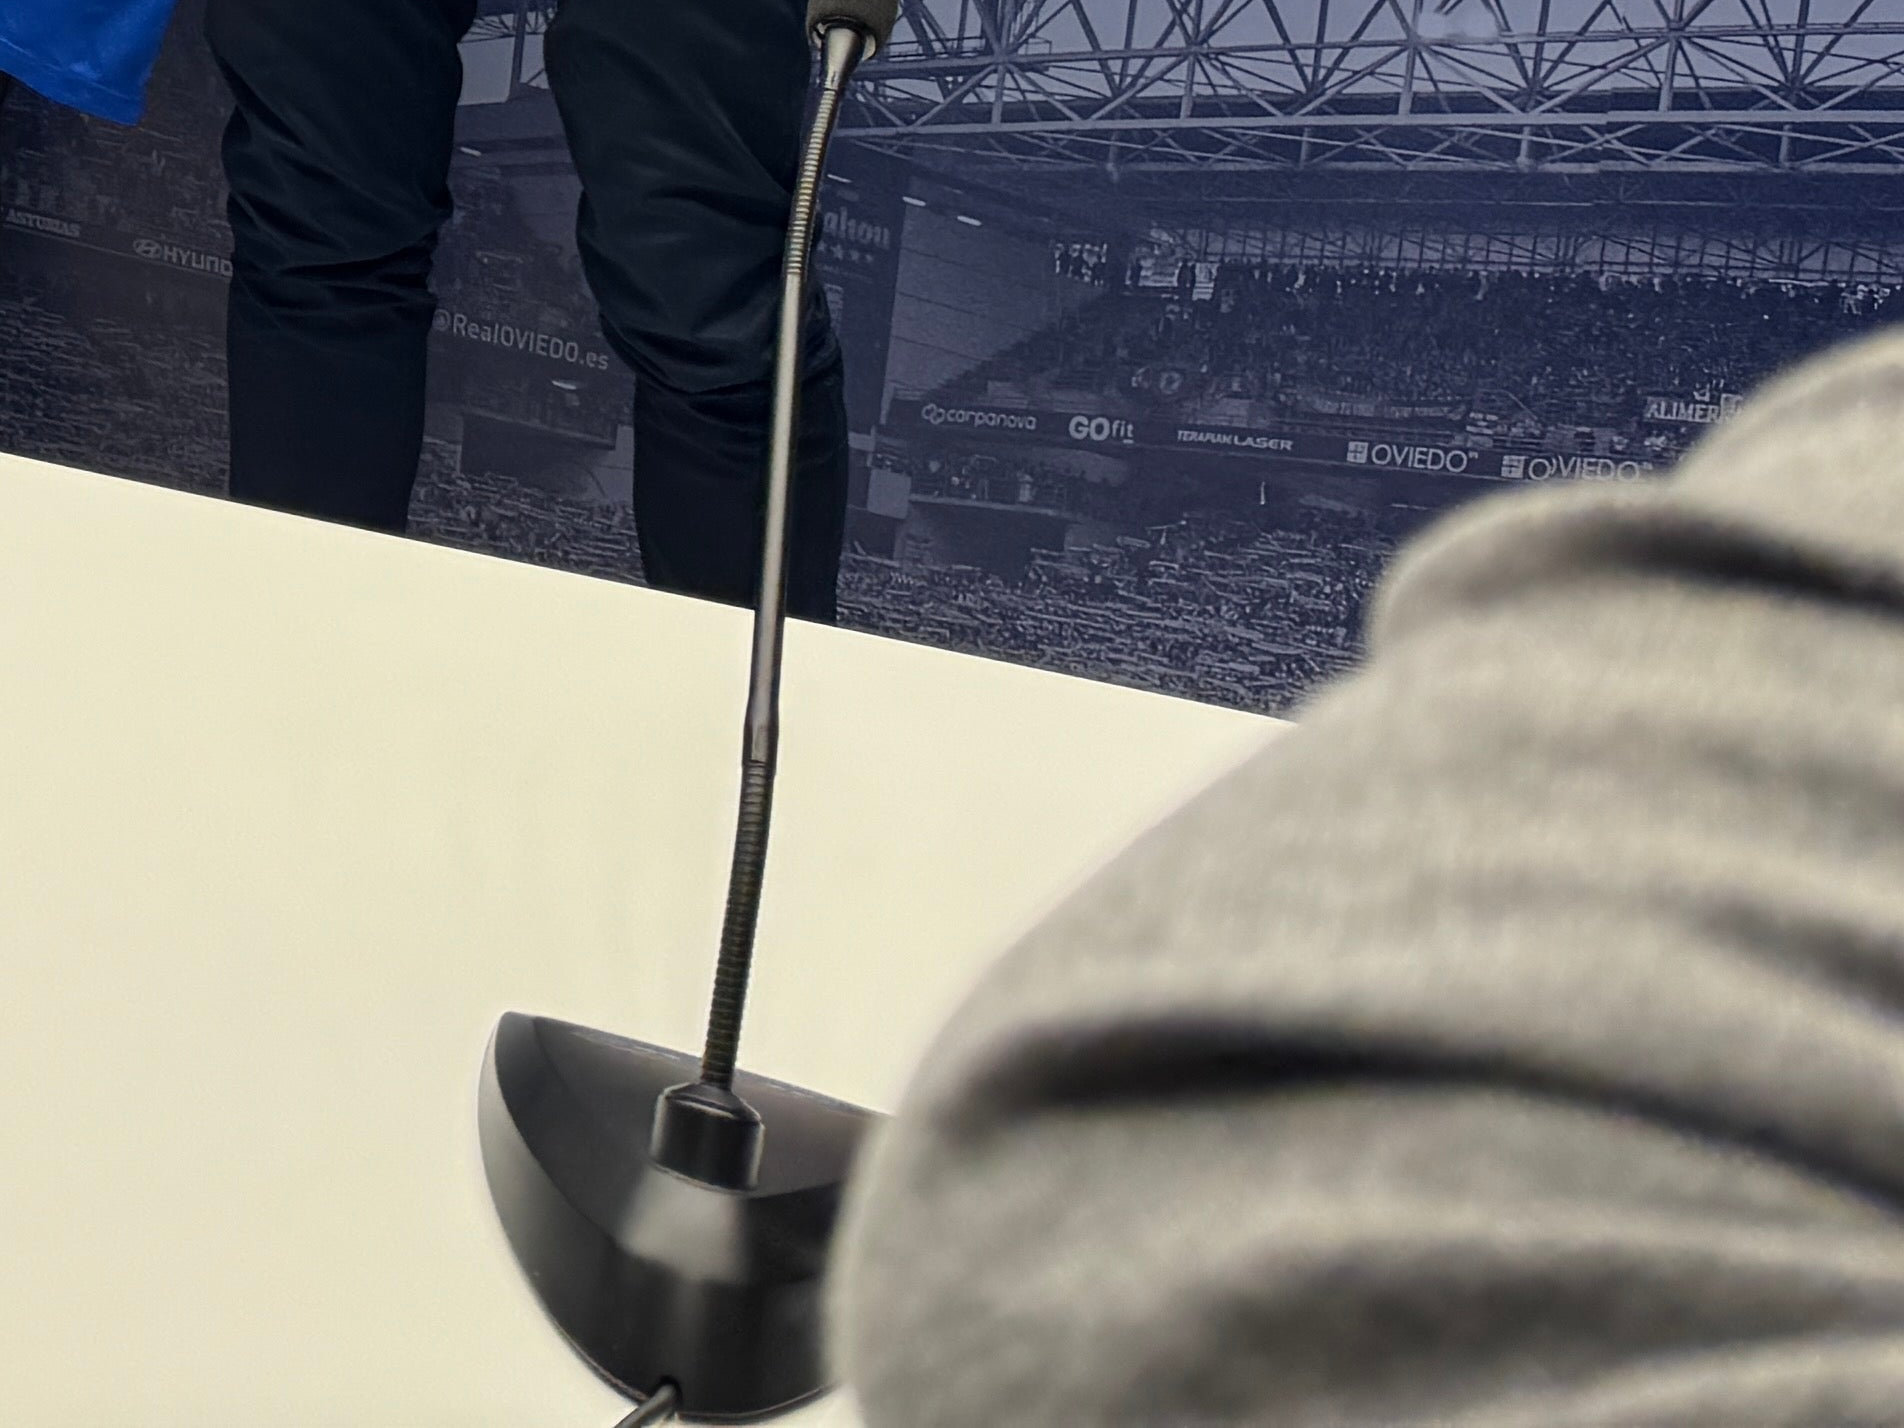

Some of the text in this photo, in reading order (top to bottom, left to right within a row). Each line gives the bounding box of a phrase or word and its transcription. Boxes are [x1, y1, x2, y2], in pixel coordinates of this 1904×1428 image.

[162, 245, 232, 277] HYUND
[947, 409, 1037, 430] carpanova
[1371, 444, 1468, 472] OVIEDO
